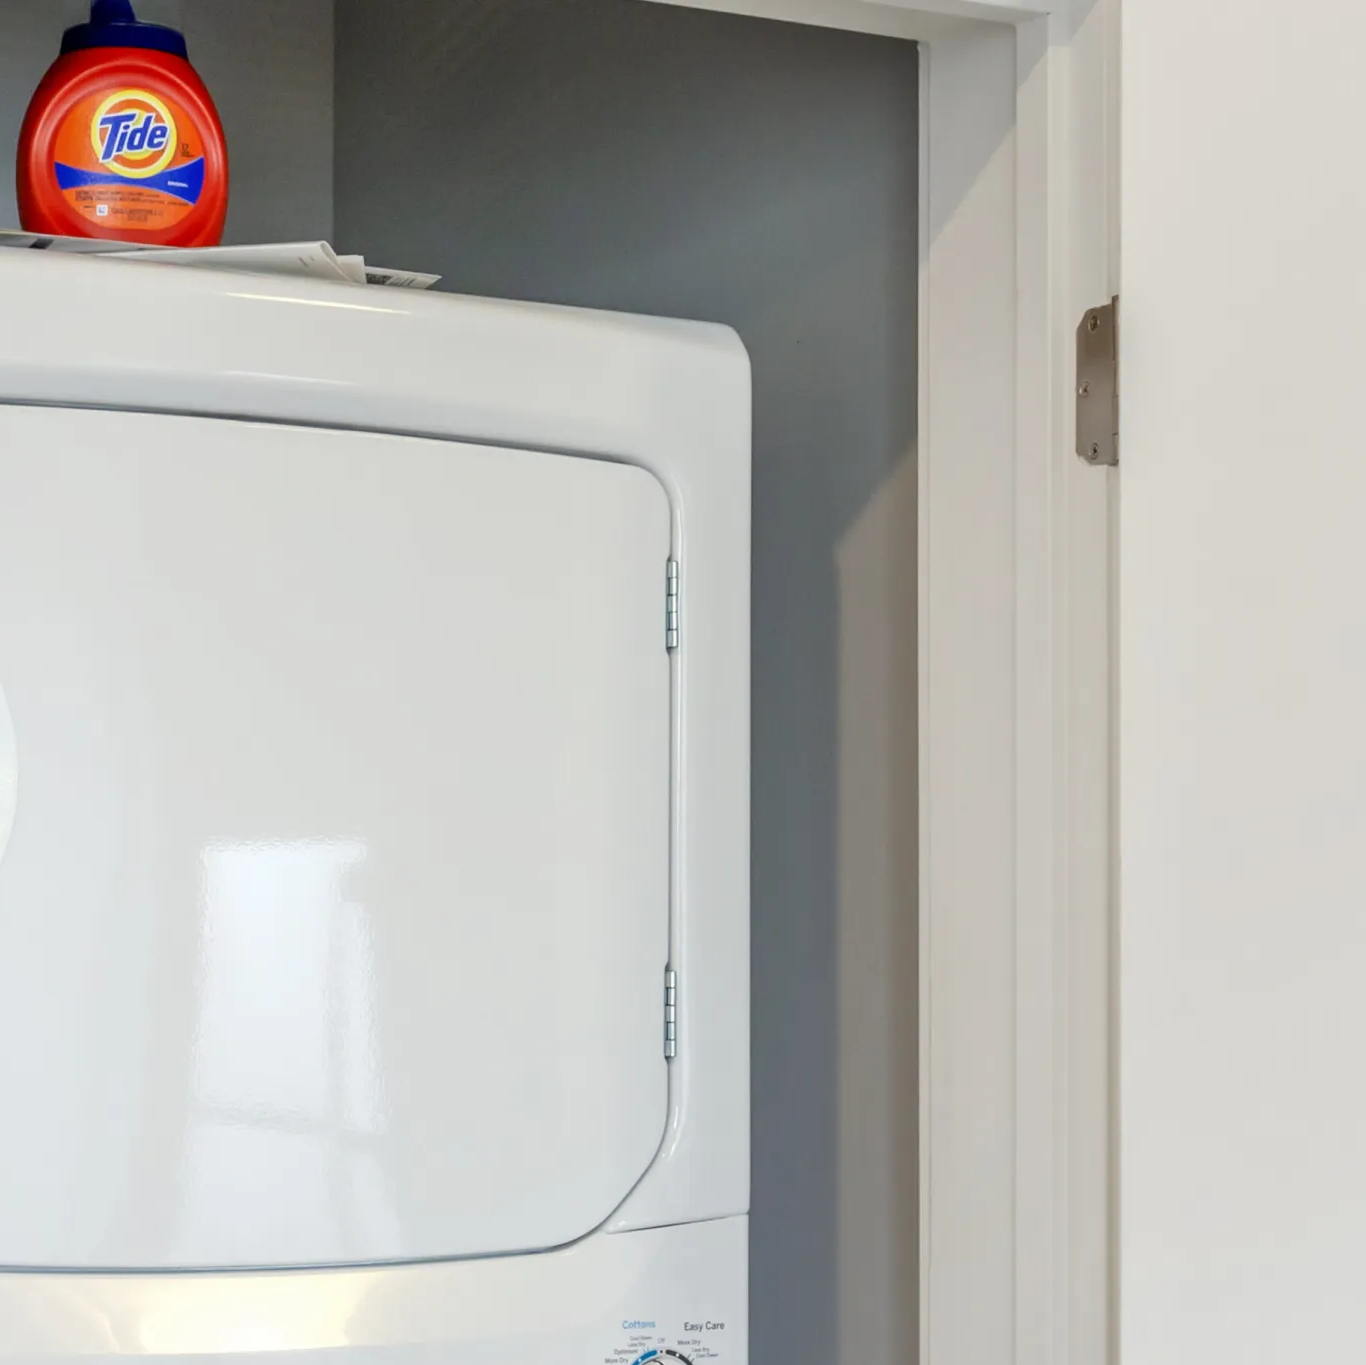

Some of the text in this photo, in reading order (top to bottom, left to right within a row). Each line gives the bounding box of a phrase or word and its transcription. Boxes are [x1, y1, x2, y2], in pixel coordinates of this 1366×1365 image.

[99, 112, 169, 163] Tide
[622, 1320, 655, 1330] Cottons
[684, 1320, 725, 1332] Easy Care
